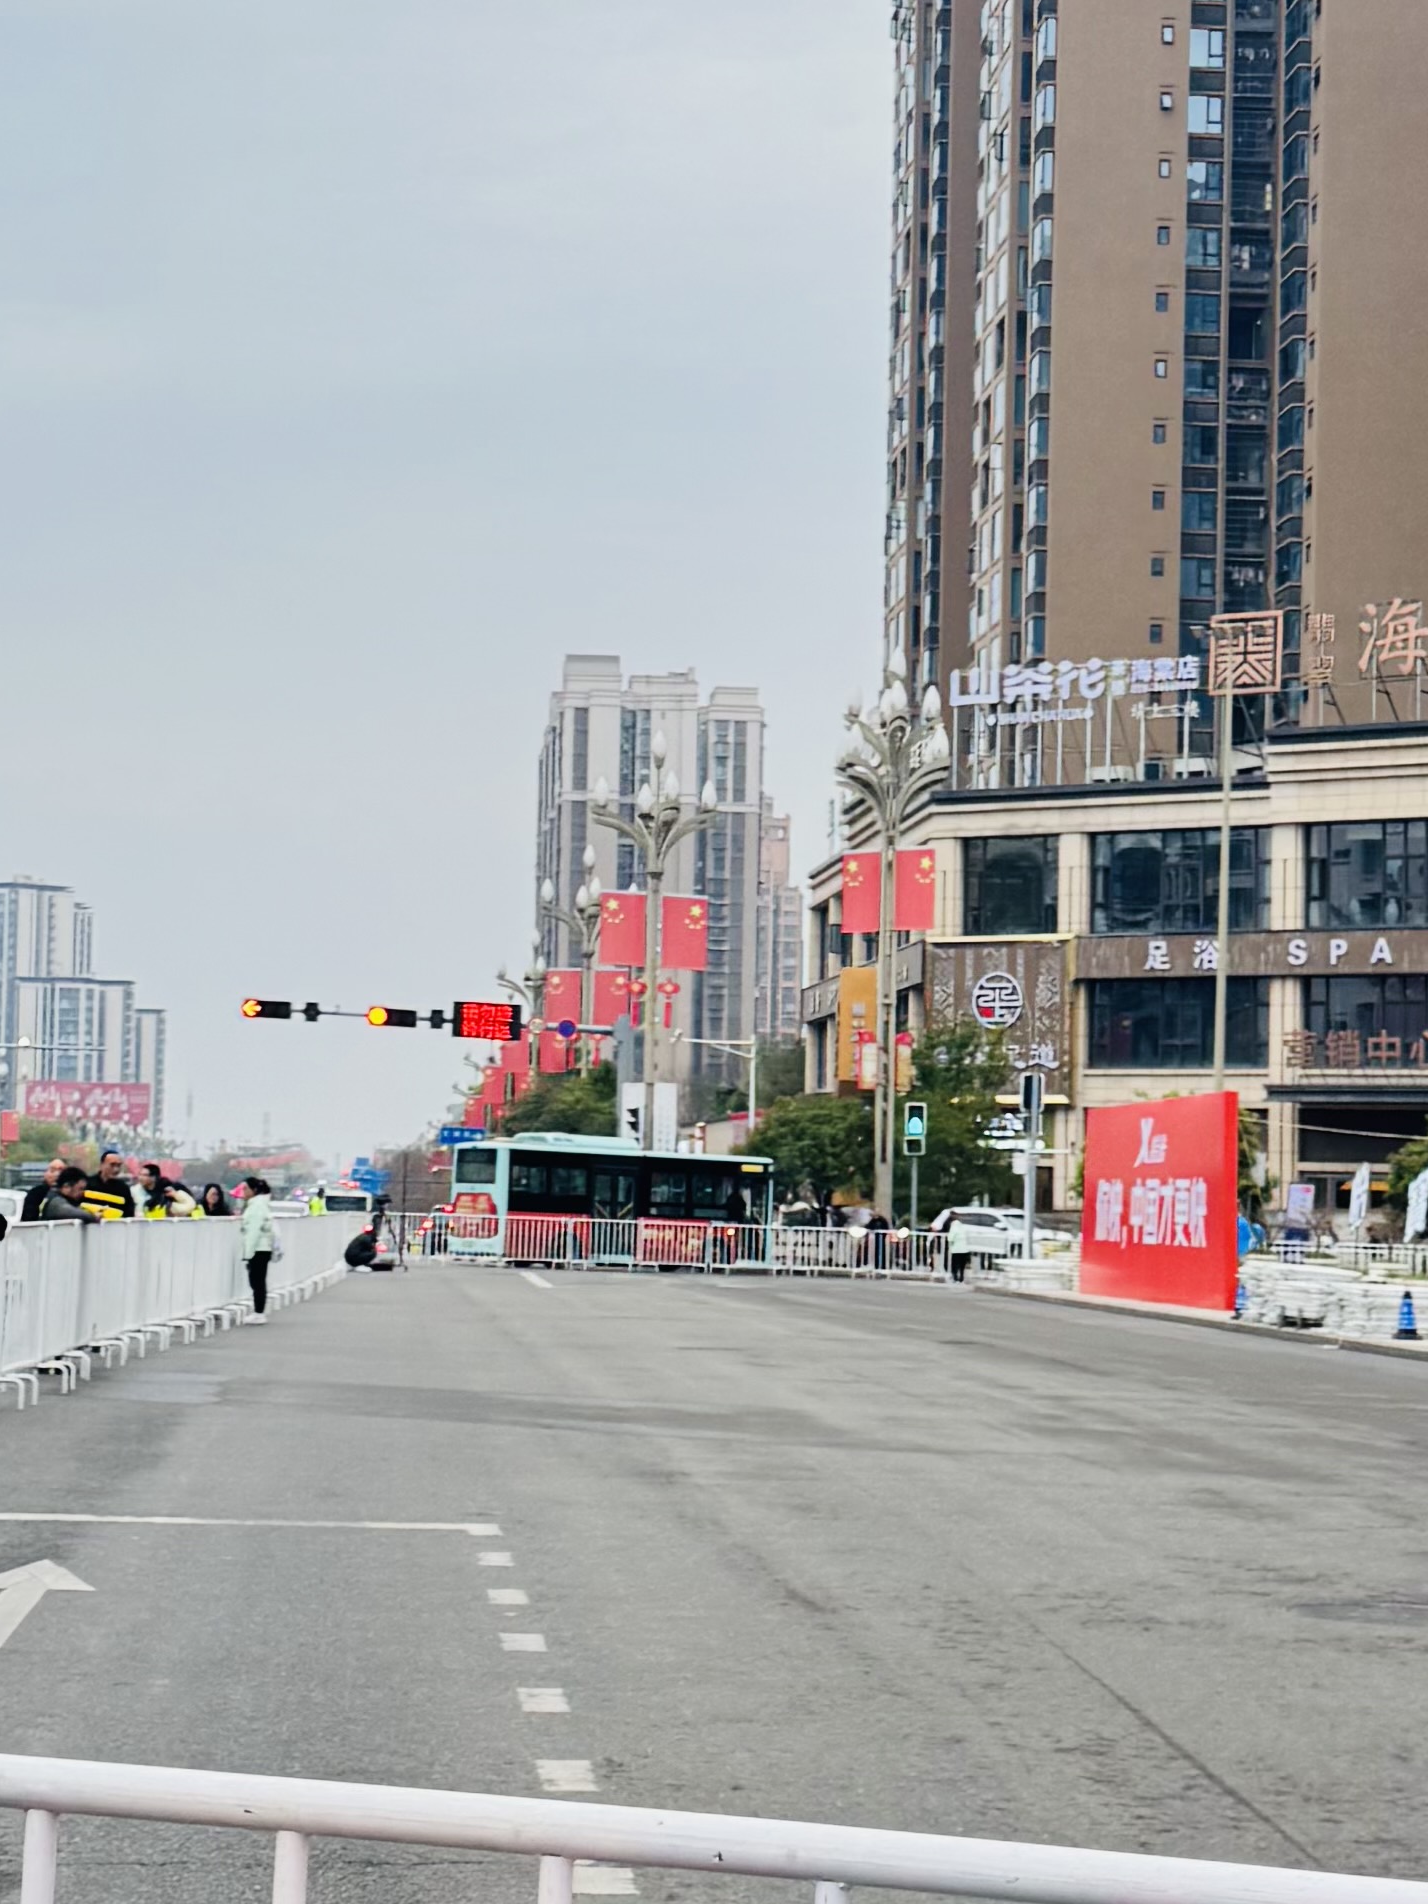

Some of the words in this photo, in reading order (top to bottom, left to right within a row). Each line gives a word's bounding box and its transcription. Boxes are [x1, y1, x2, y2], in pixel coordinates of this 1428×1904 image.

[949, 656, 1106, 707] 山茶花
[1286, 937, 1392, 966] SPA
